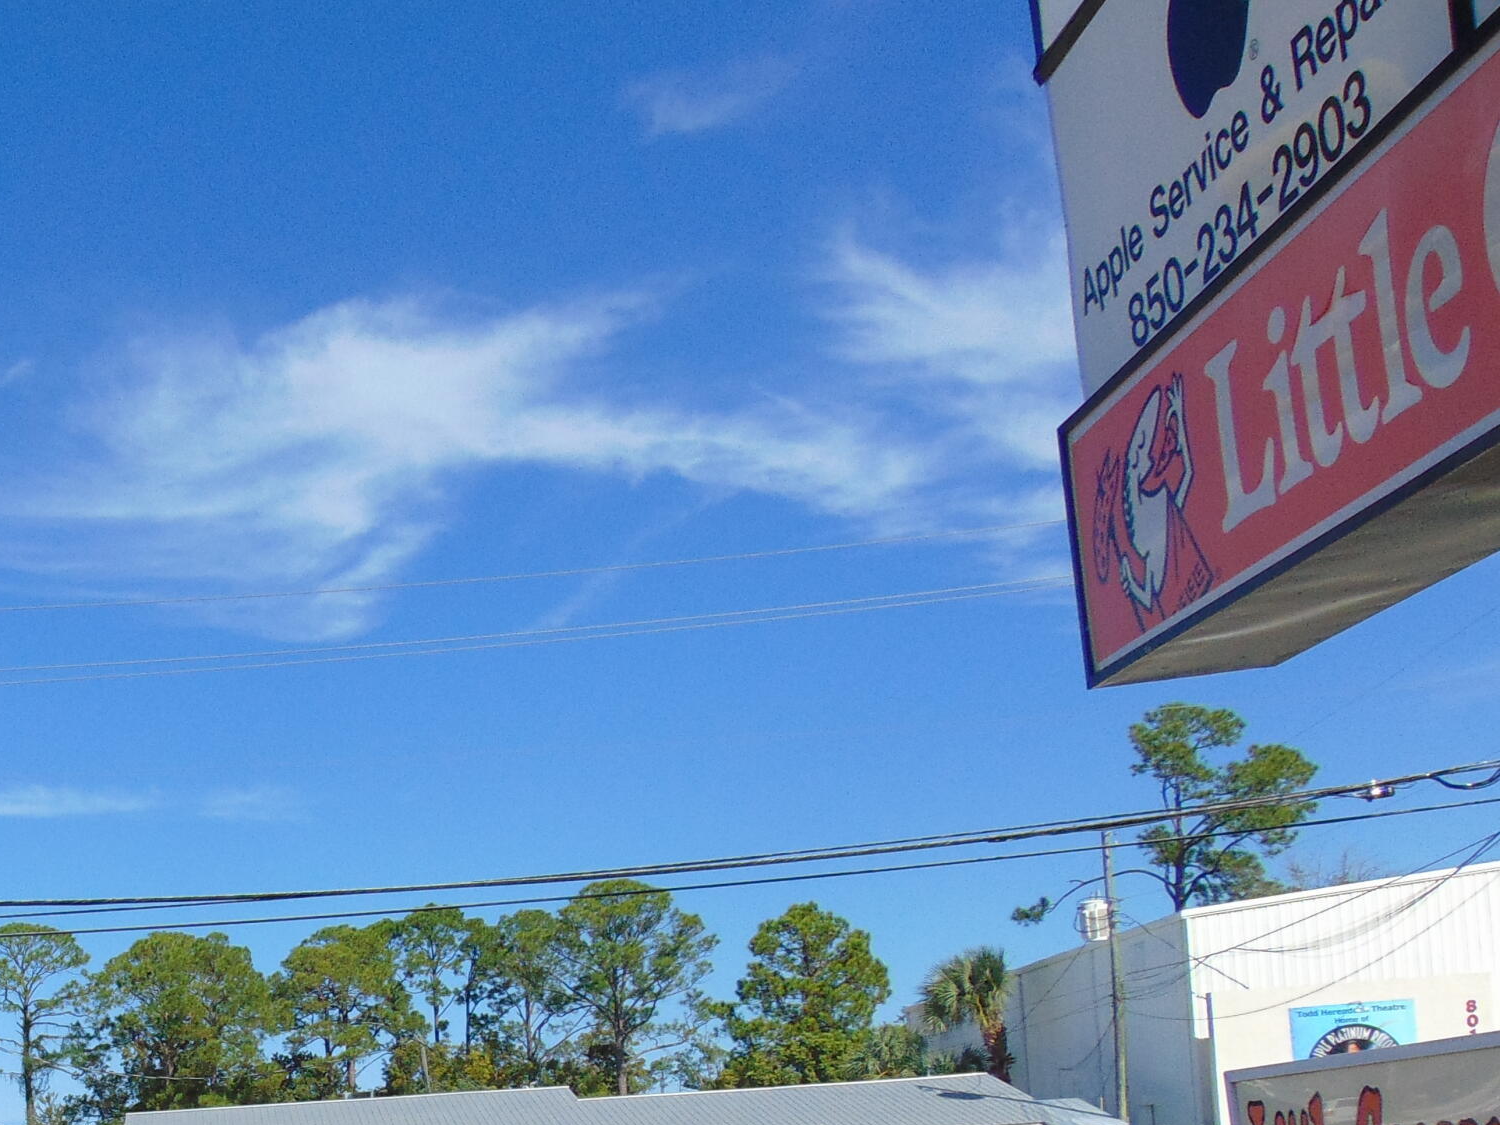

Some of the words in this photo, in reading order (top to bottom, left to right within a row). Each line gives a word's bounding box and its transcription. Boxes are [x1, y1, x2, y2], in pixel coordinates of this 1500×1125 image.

[1084, 223, 1145, 317] Apple
[1149, 109, 1250, 239] Service
[1259, 64, 1285, 124] &
[1289, 0, 1391, 92] Repa
[1127, 70, 1373, 348] 850-234-2903
[1204, 207, 1471, 535] Little
[1371, 1003, 1408, 1014] Theatre
[1465, 1000, 1480, 1034] 80
